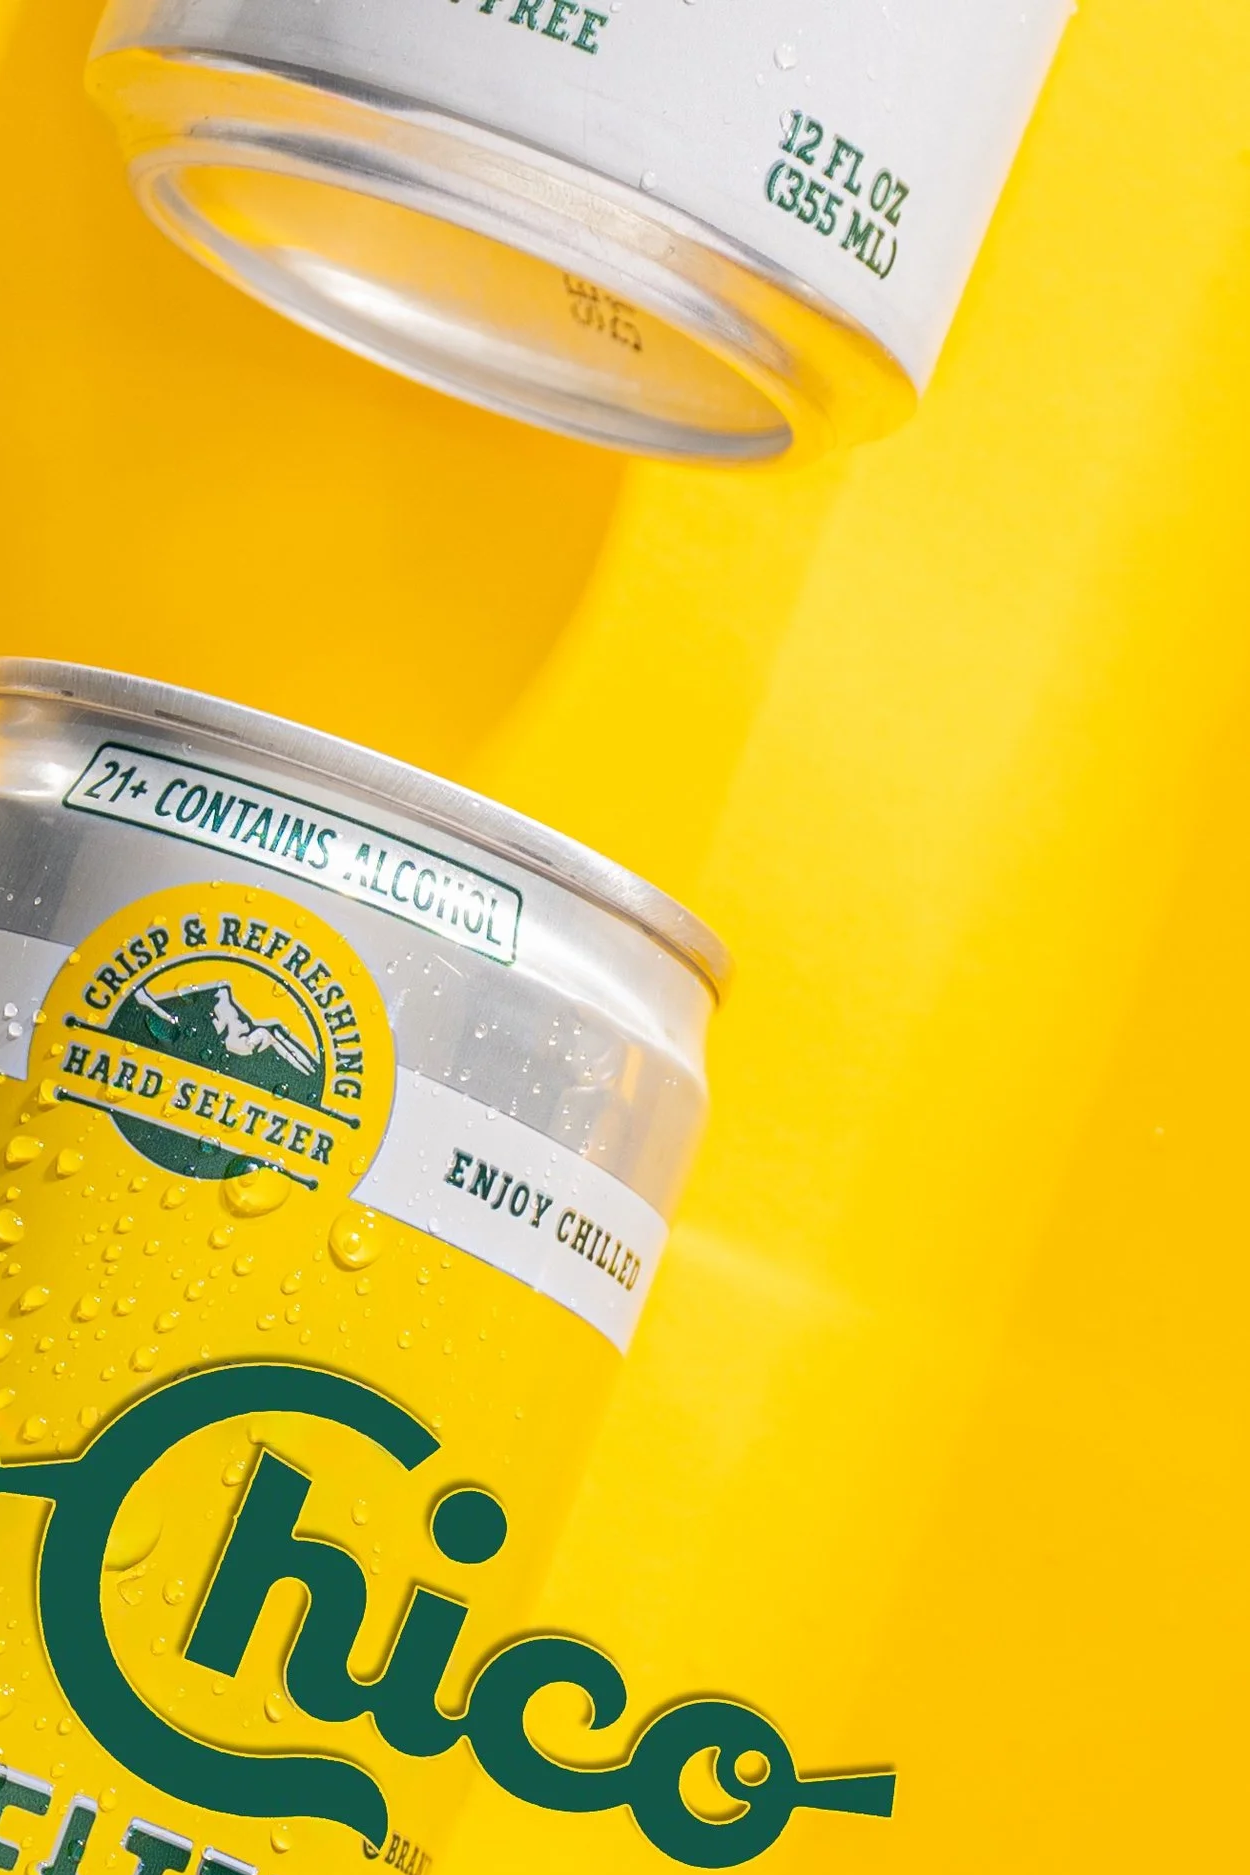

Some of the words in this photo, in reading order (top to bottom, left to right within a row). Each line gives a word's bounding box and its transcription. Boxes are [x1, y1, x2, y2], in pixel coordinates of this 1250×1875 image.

[765, 159, 844, 236] (355
[839, 207, 898, 281] ML)
[779, 110, 824, 166] 12
[823, 134, 865, 196] FL
[869, 168, 910, 228] OZ
[84, 761, 147, 803] 21+
[155, 778, 338, 870] CONTAINS
[343, 843, 502, 945] ALCOHOL
[84, 927, 169, 1010] CRISP
[183, 917, 207, 948] &
[220, 916, 364, 1100] REFRESHING
[62, 1044, 164, 1099] HARD
[174, 1080, 335, 1166] SELTZER
[443, 1148, 554, 1229] ENJOY
[555, 1207, 642, 1292] CHILLED
